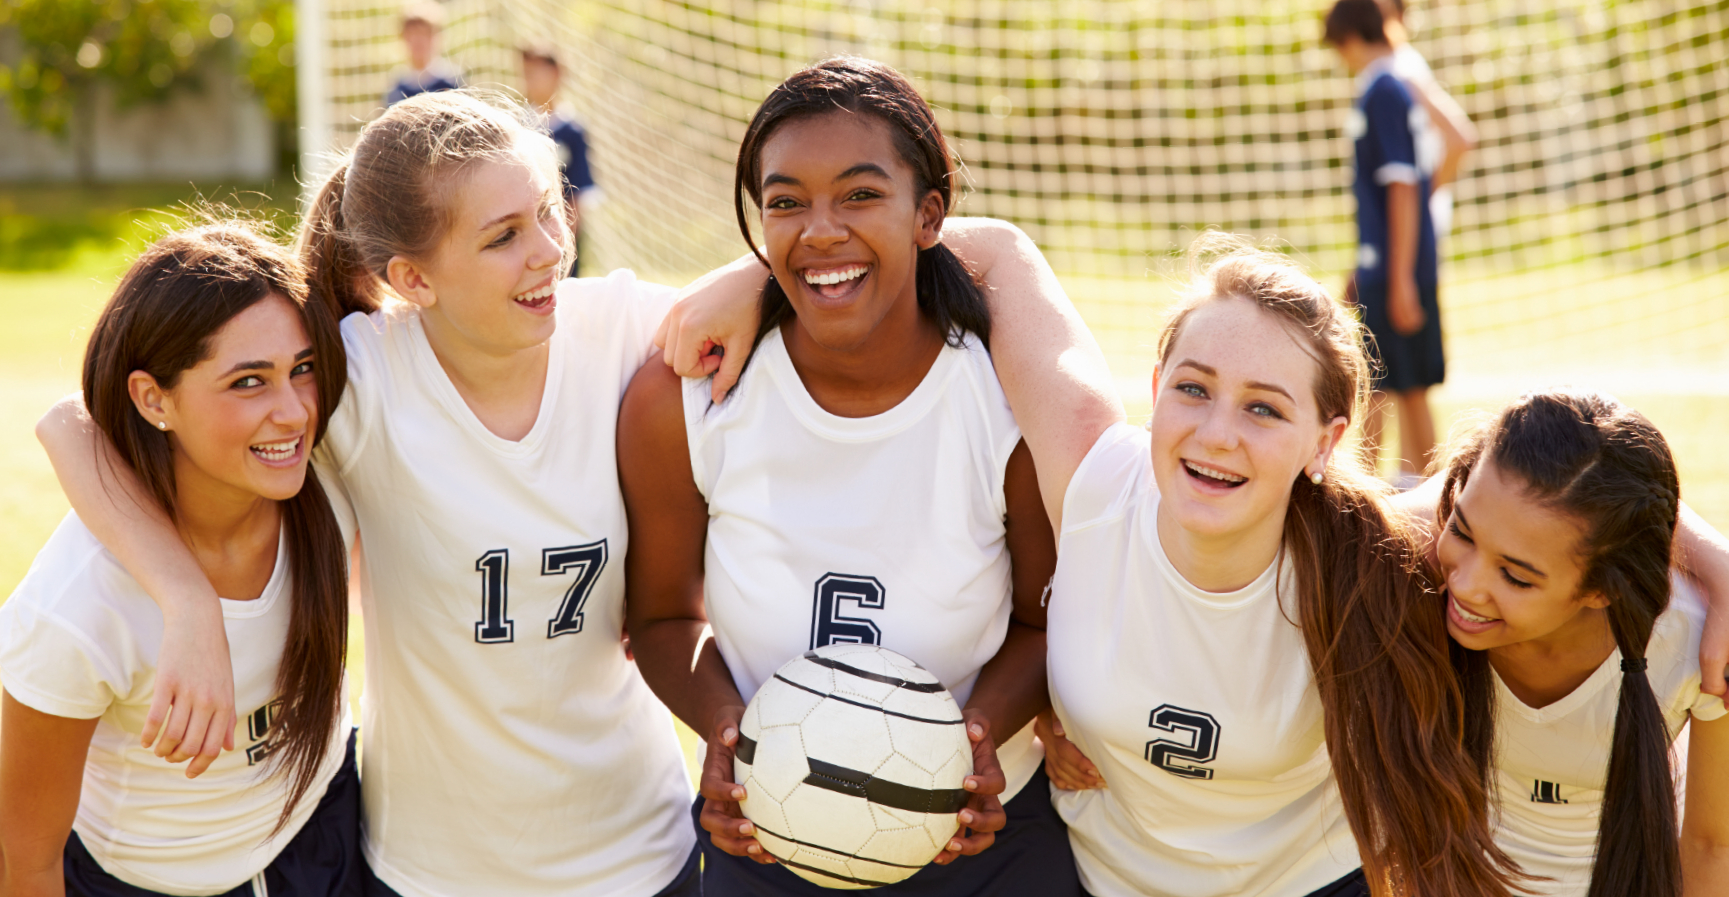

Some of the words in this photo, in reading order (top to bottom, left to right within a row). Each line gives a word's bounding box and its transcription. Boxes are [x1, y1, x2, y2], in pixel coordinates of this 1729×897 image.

[475, 538, 608, 644] 17
[809, 572, 886, 650] 6
[1144, 703, 1221, 780] 2
